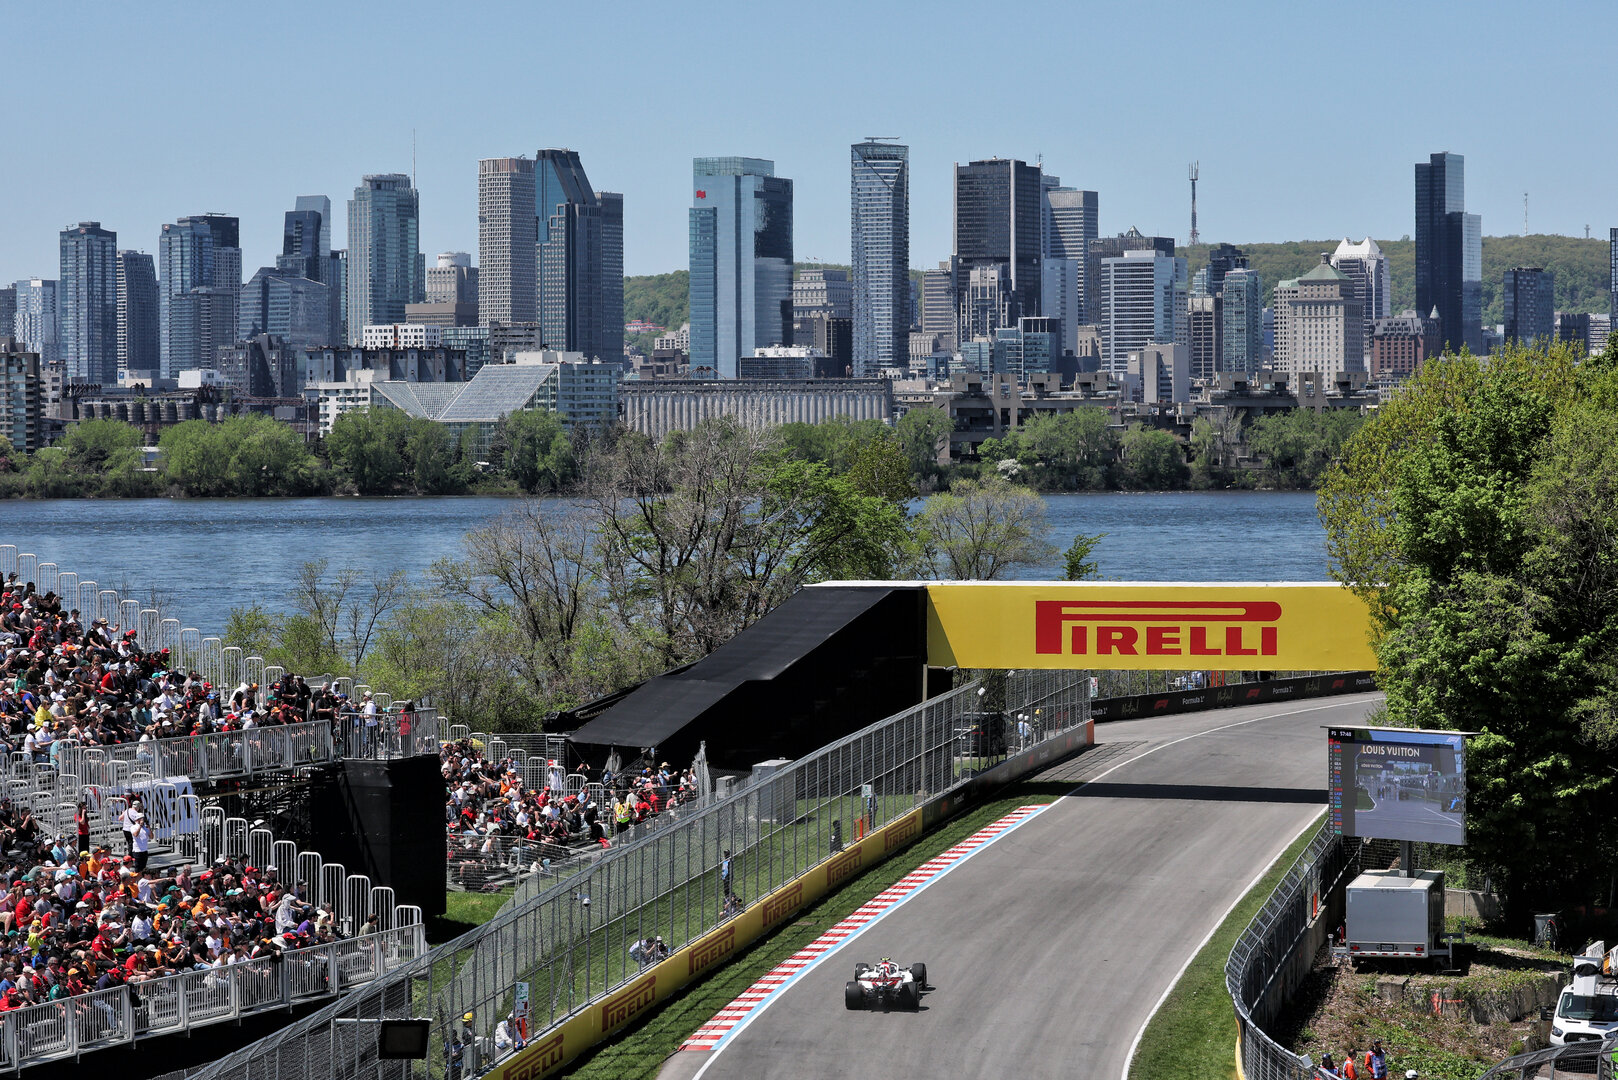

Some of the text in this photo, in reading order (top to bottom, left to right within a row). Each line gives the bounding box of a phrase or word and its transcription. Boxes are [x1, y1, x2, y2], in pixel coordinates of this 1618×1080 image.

[1036, 600, 1282, 656] PIRELLI
[1182, 696, 1200, 705] Formula
[1272, 687, 1289, 695] Formula
[1362, 745, 1420, 757] LOUIS VUITTON
[885, 816, 917, 851] PIRELLI
[827, 846, 862, 887] PIRELLI
[763, 882, 803, 928] PIRELLI
[689, 926, 736, 976] PIRELLI
[602, 975, 656, 1033] PIRELLI
